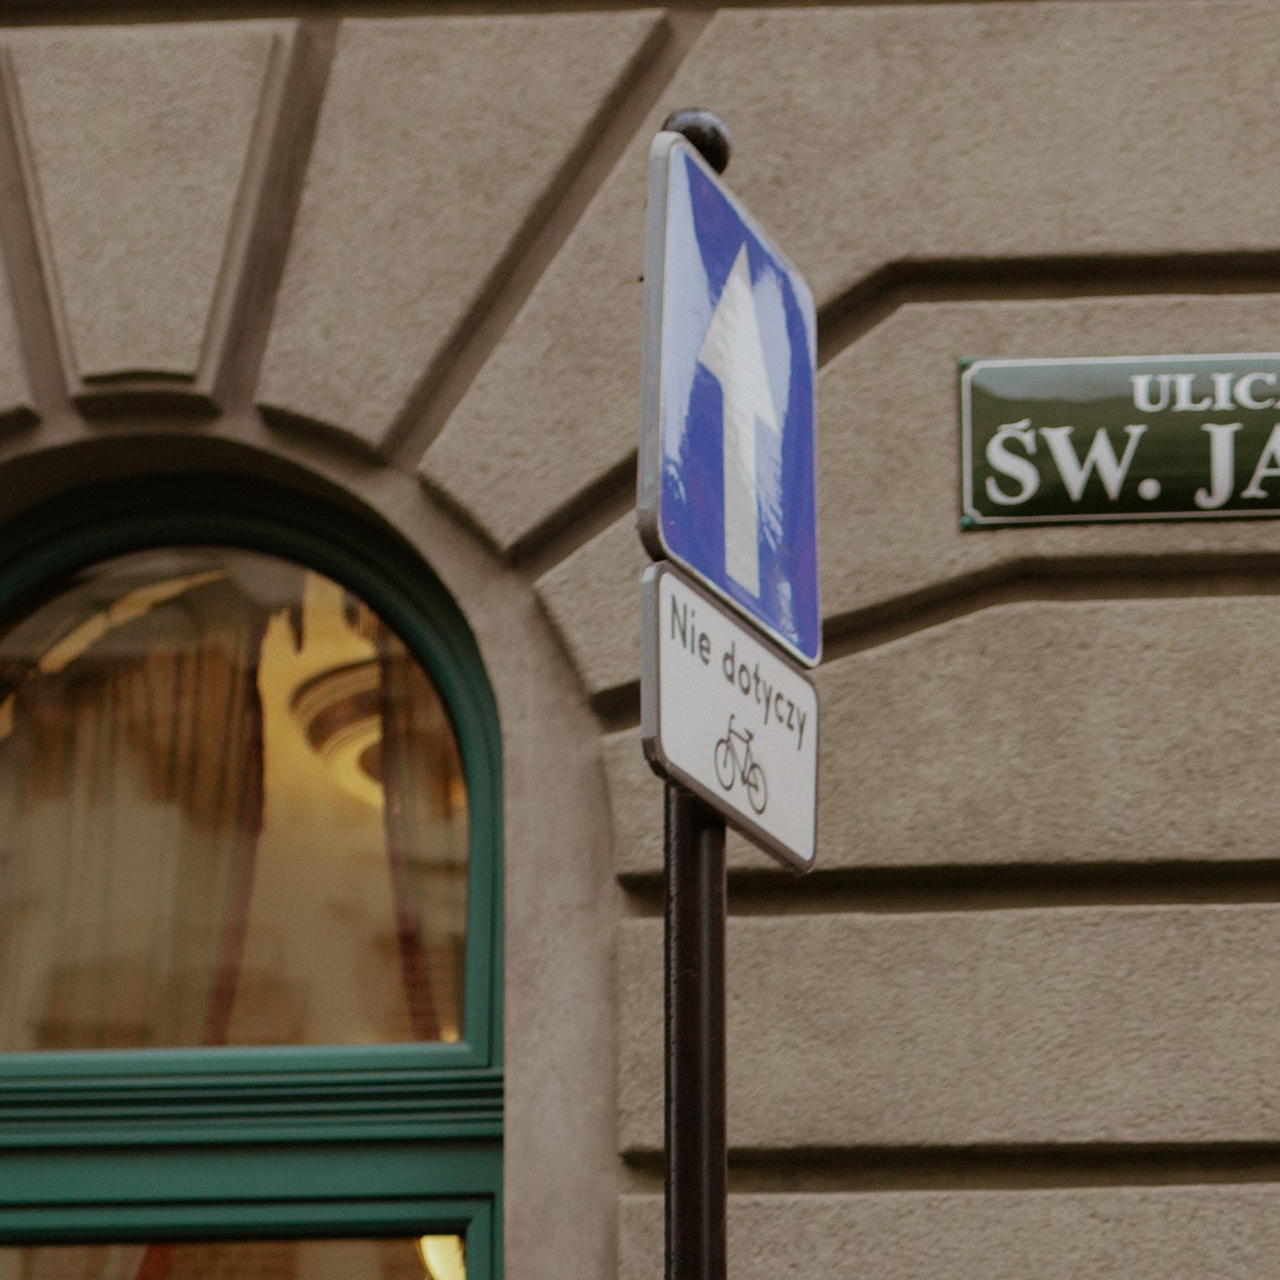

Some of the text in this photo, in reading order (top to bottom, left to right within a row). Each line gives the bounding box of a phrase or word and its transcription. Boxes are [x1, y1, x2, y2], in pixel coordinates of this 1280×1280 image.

[984, 417, 1162, 505] ŚW.
[670, 593, 807, 751] Nie dotyczy
